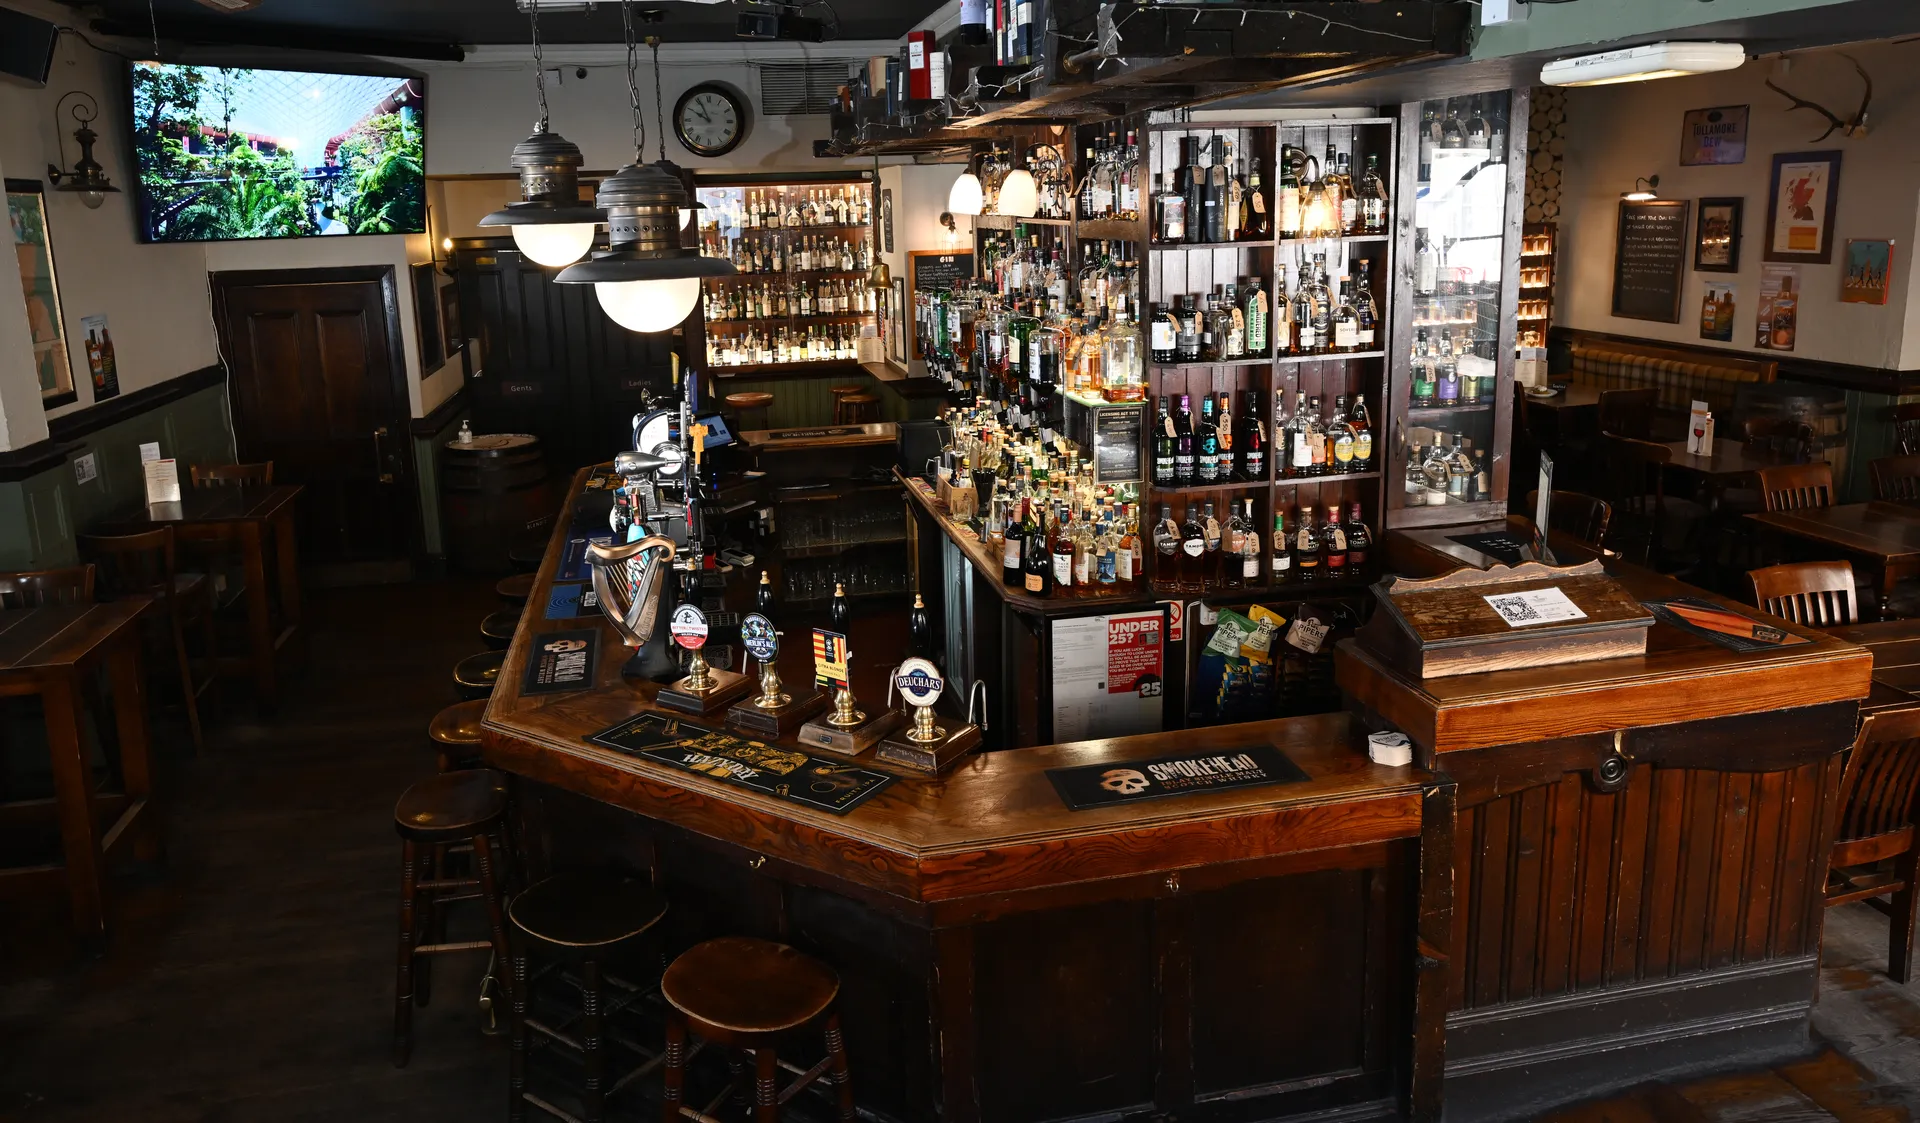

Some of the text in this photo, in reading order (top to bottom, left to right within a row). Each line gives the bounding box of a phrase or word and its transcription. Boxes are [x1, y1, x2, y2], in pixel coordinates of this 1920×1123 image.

[1692, 122, 1737, 136] TULLAMORE
[1703, 136, 1722, 148] DEW
[1109, 620, 1159, 634] UNDER
[1298, 624, 1324, 638] PIPERS
[1109, 633, 1134, 645] 25?
[898, 677, 940, 690] DEUCHARS
[1141, 682, 1161, 696] 25
[1148, 754, 1258, 781] SMOKEHEAD
[1218, 773, 1268, 783] WHISKY
[835, 787, 862, 803] FRUITY
